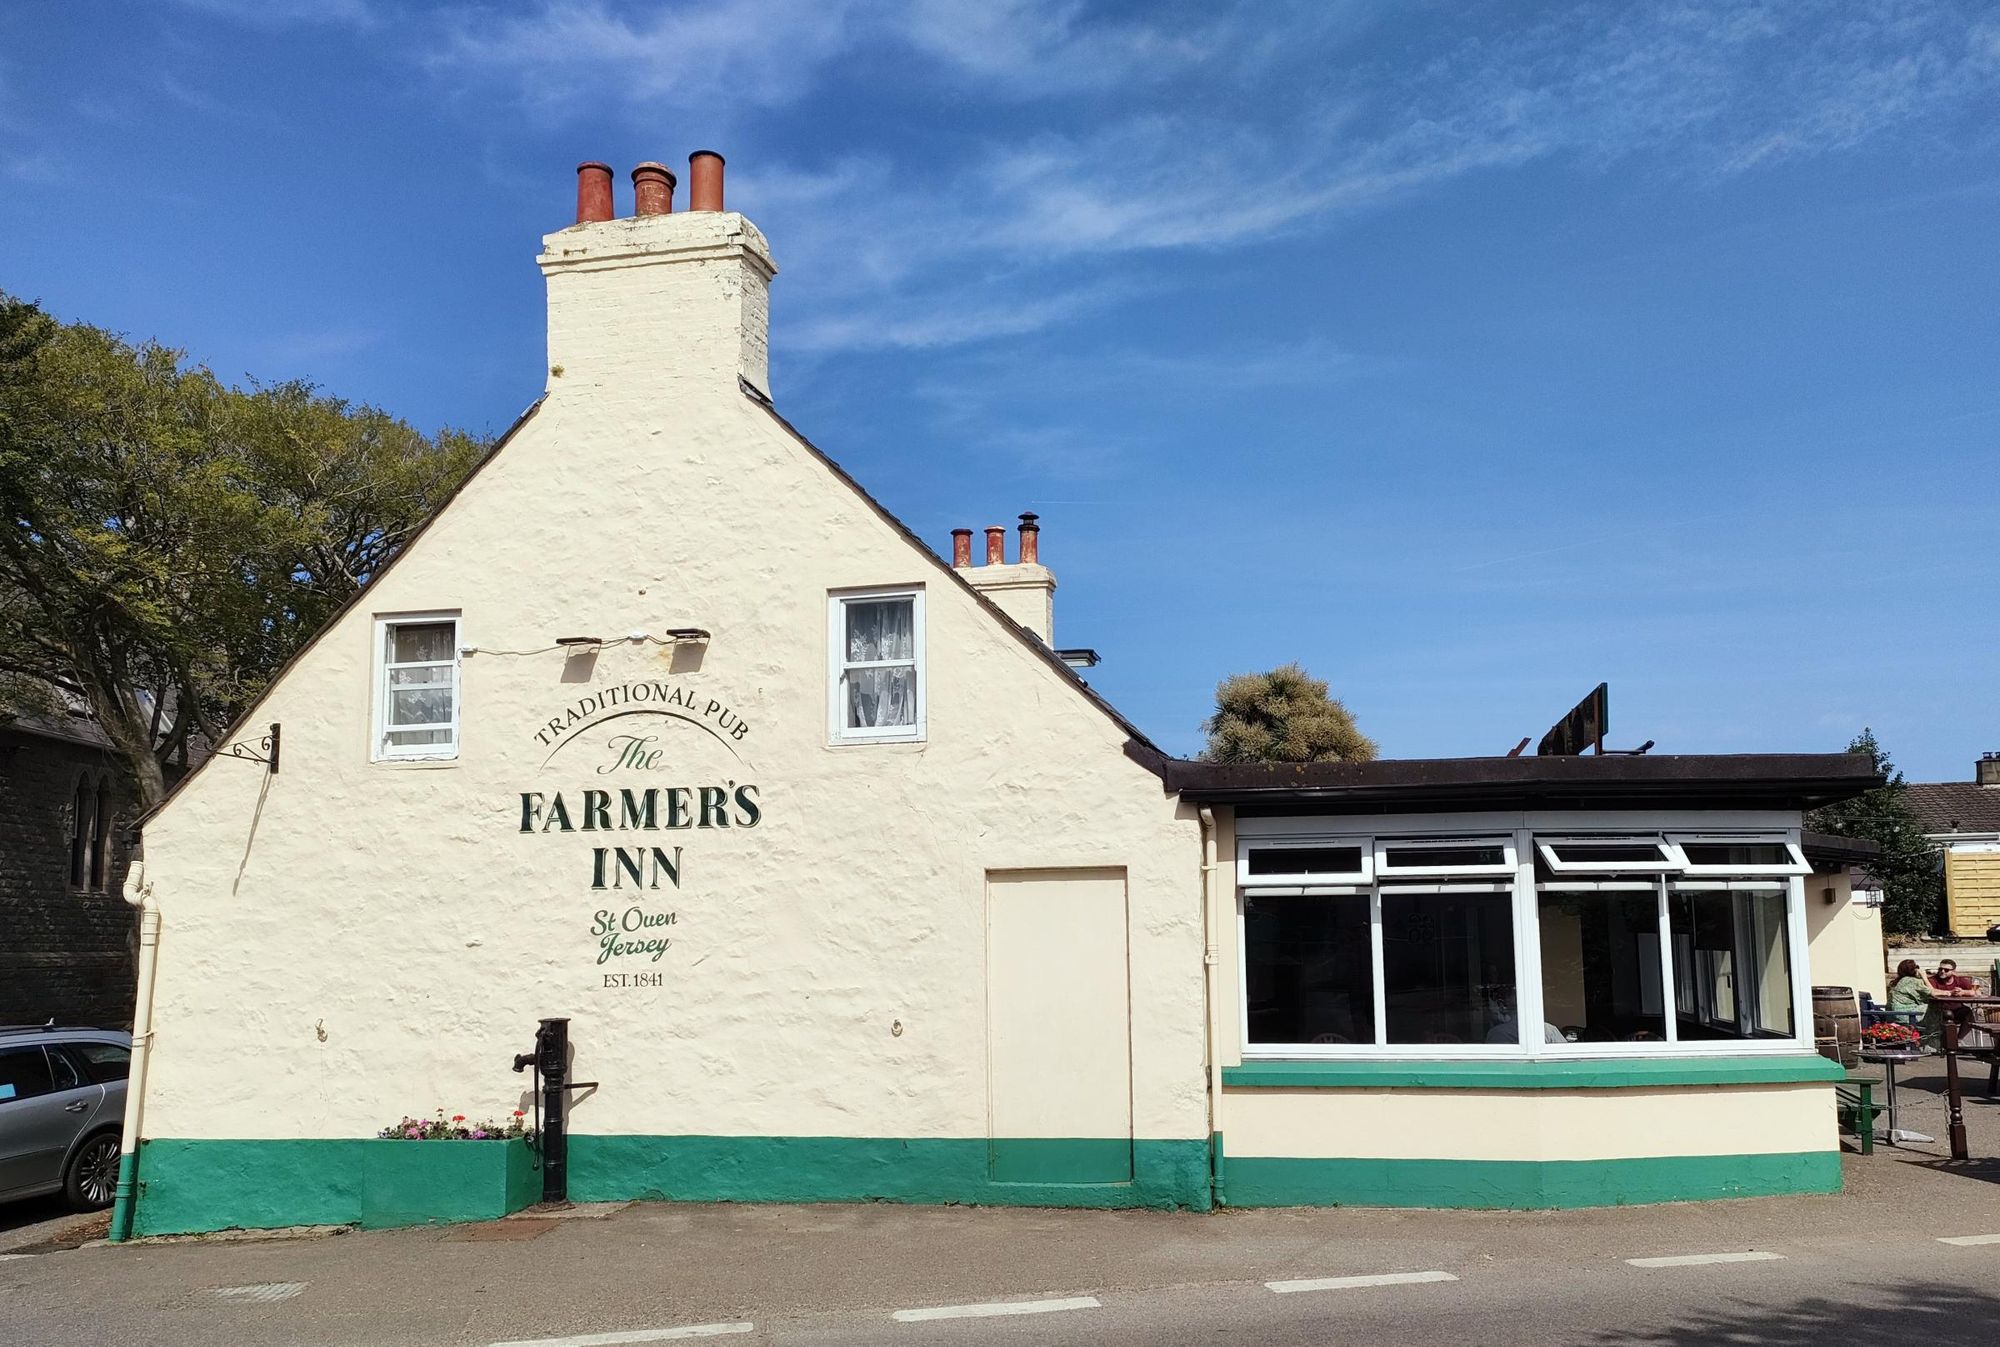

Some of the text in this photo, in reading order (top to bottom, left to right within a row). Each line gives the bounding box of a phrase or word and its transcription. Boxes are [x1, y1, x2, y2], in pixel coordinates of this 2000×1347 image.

[534, 683, 749, 747] TRADITIONAL PUB
[596, 735, 664, 775] The
[519, 780, 762, 834] FARMER'S
[590, 846, 683, 890] INN
[590, 906, 677, 936] St Ouen
[596, 931, 672, 965] Jersey
